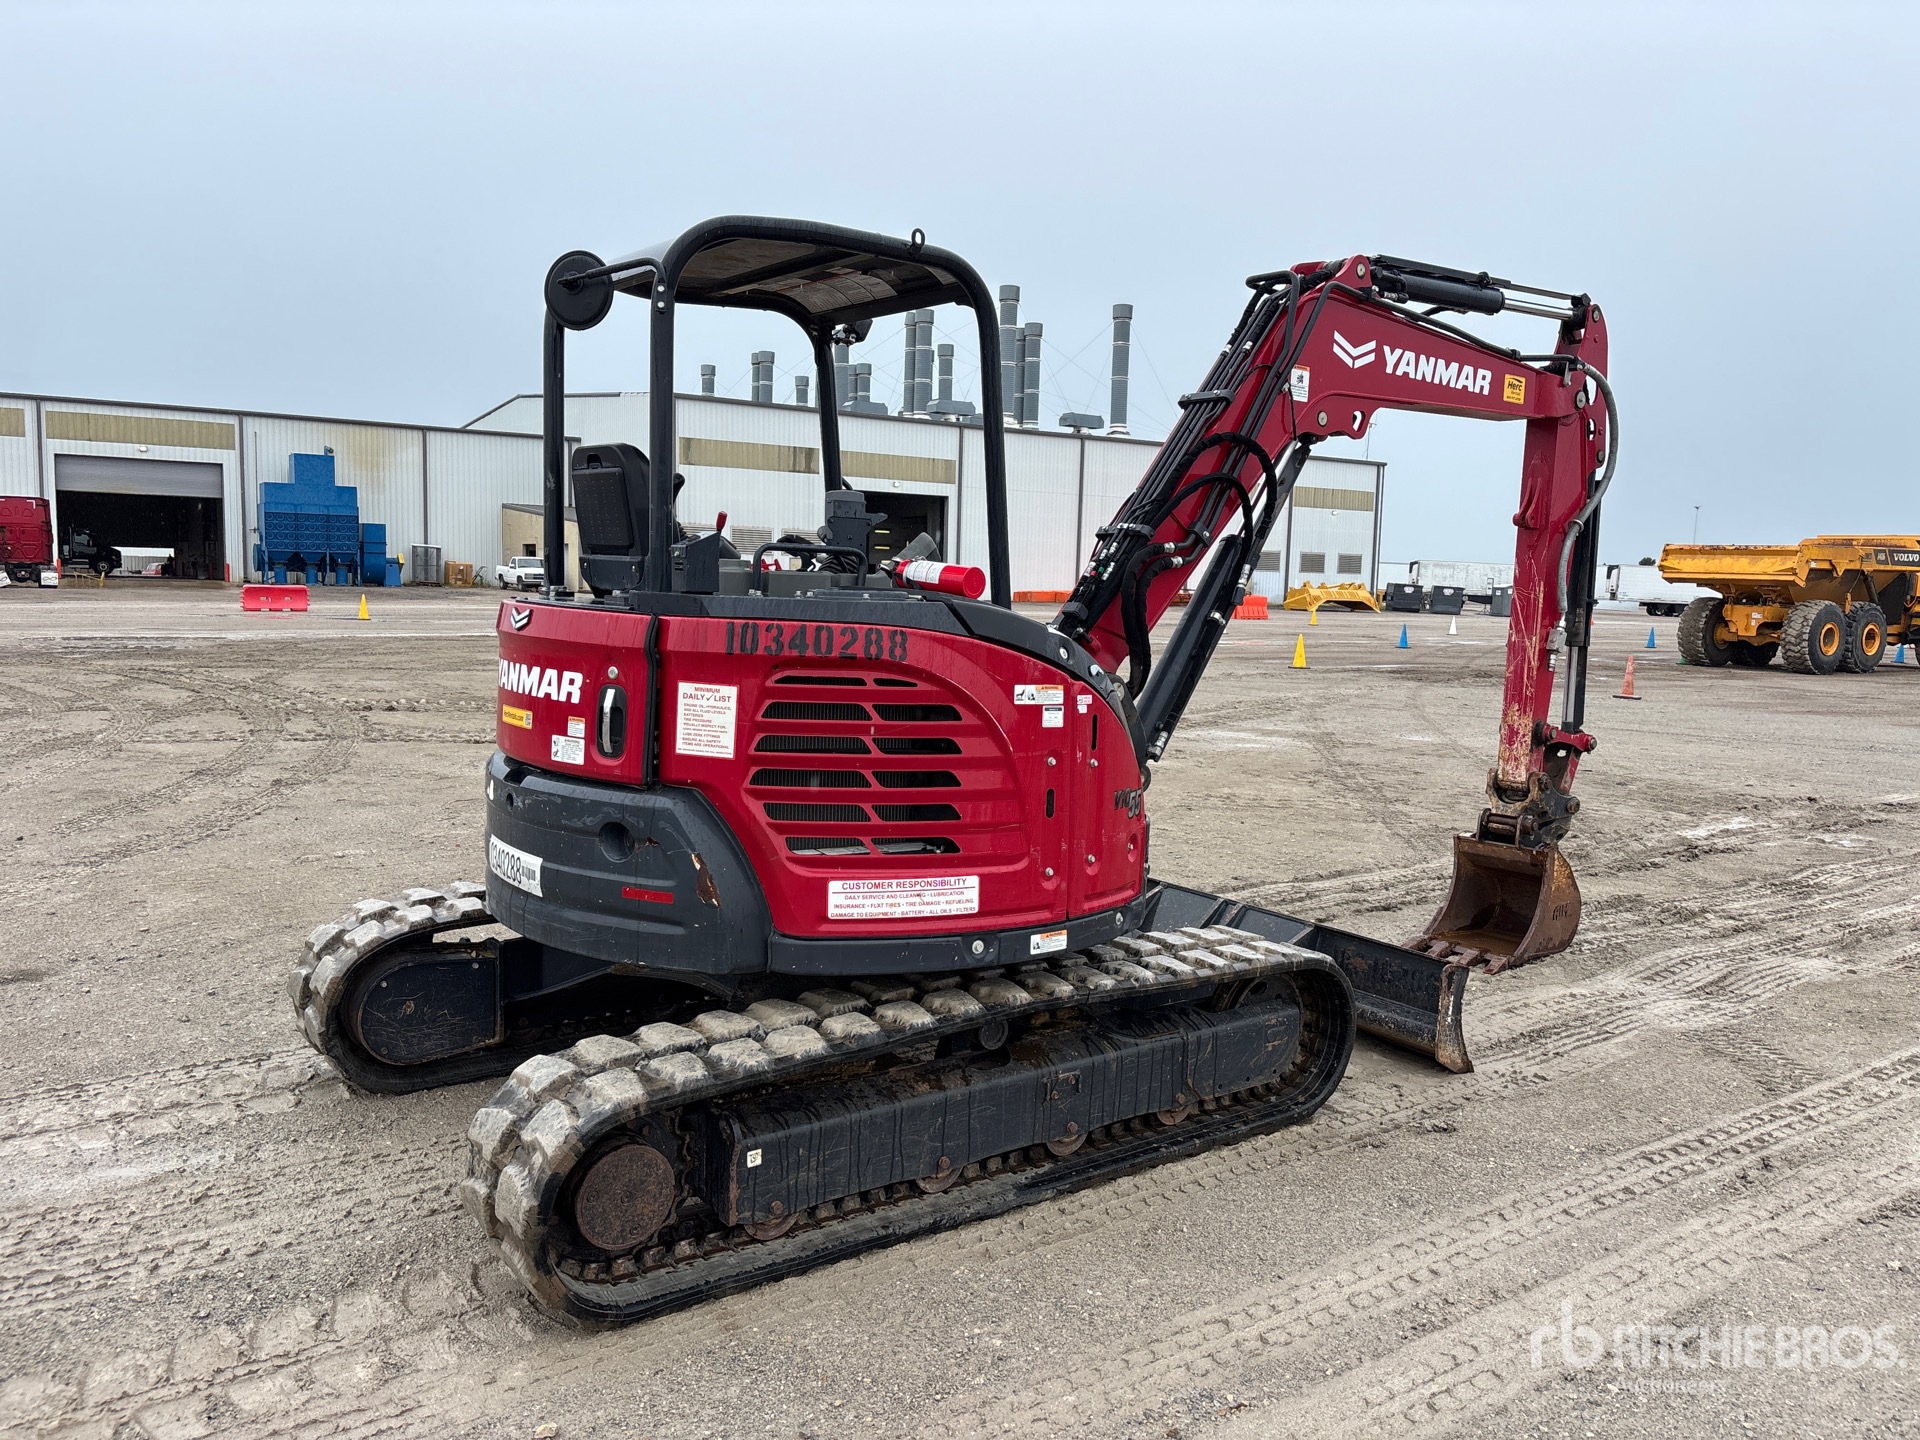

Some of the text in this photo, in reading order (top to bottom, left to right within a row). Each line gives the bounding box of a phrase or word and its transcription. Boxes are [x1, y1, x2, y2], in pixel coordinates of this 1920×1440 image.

[1383, 345, 1492, 396] YANMAR
[1507, 380, 1523, 392] Herc
[1893, 553, 1920, 562] VOLVO
[725, 621, 908, 662] 10340288
[683, 692, 705, 700] DAILY
[841, 878, 967, 891] CUSTOMER RESPONSIBILITY
[930, 890, 965, 898] LUBRICATION
